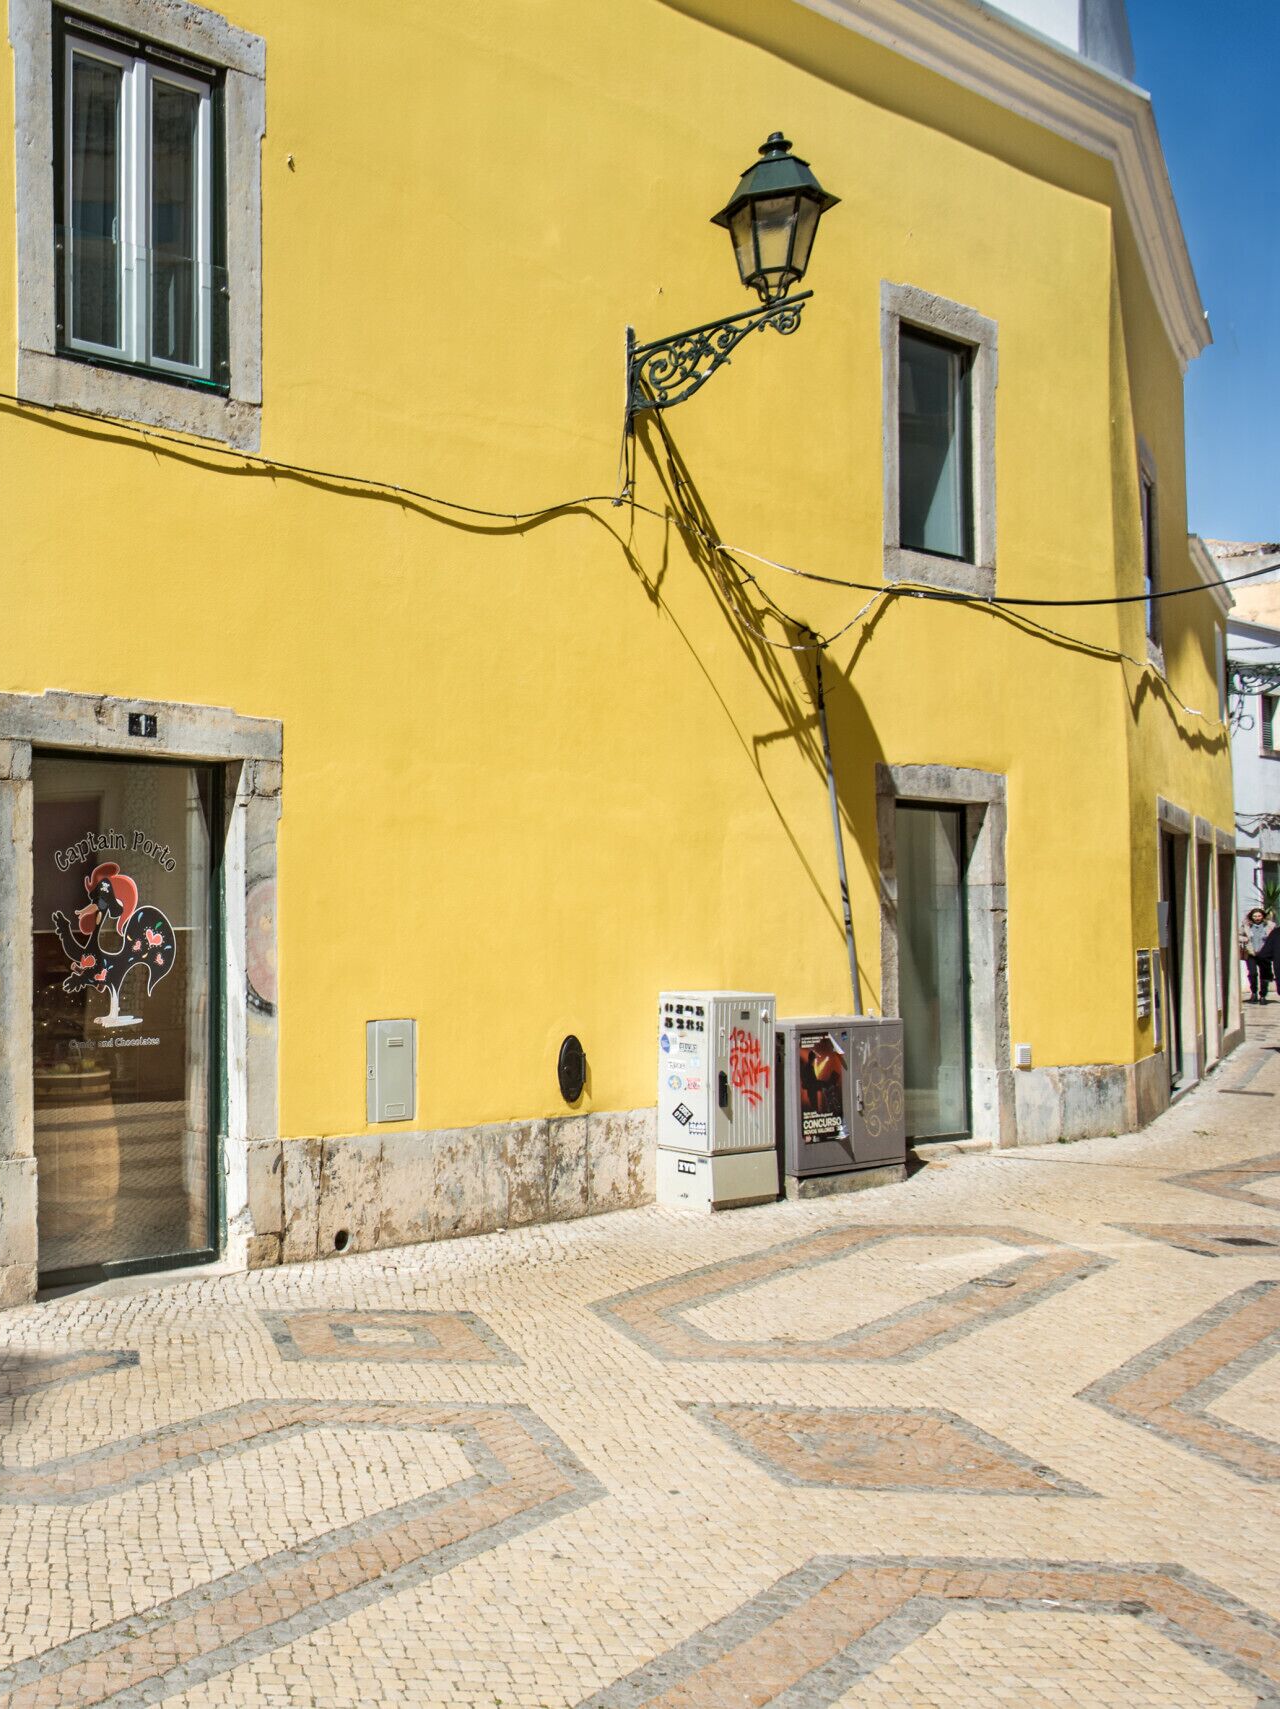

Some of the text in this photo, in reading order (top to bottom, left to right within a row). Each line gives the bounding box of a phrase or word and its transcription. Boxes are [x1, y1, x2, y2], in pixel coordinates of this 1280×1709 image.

[54, 828, 177, 873] Captain Porto
[69, 1037, 160, 1049] Candy and Chocolates
[803, 1116, 842, 1130] CONCURSO
